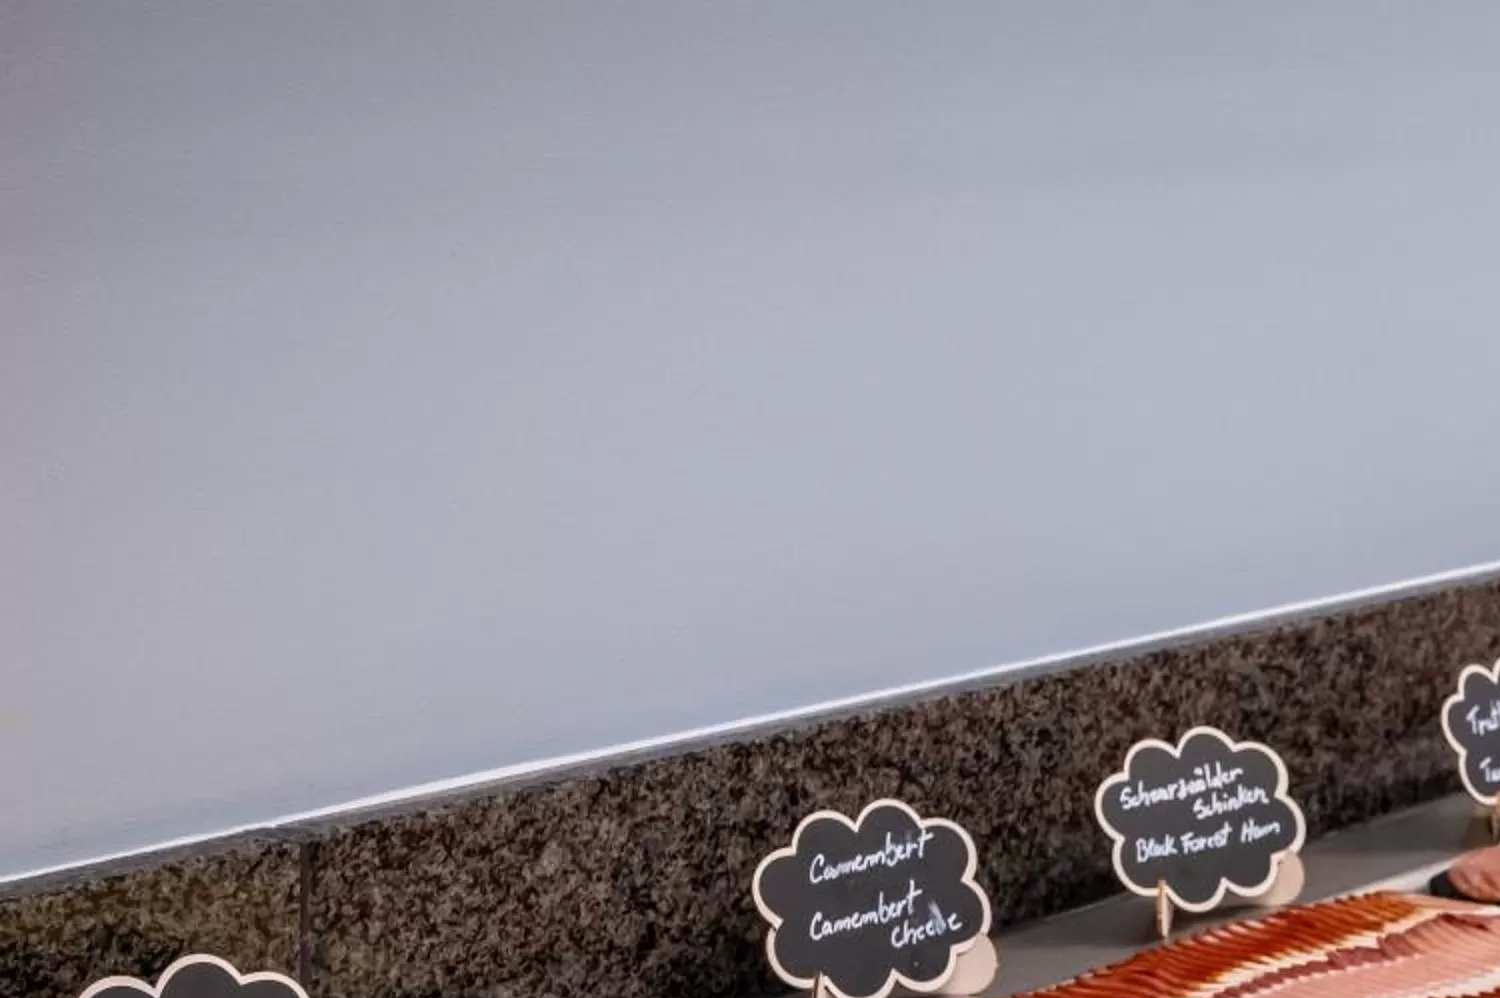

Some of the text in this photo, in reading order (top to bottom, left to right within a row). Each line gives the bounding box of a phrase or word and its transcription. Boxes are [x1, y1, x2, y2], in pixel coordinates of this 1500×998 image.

[809, 831, 934, 884] Camembert
[1240, 818, 1281, 844] Ham
[809, 879, 923, 941] Camembert
